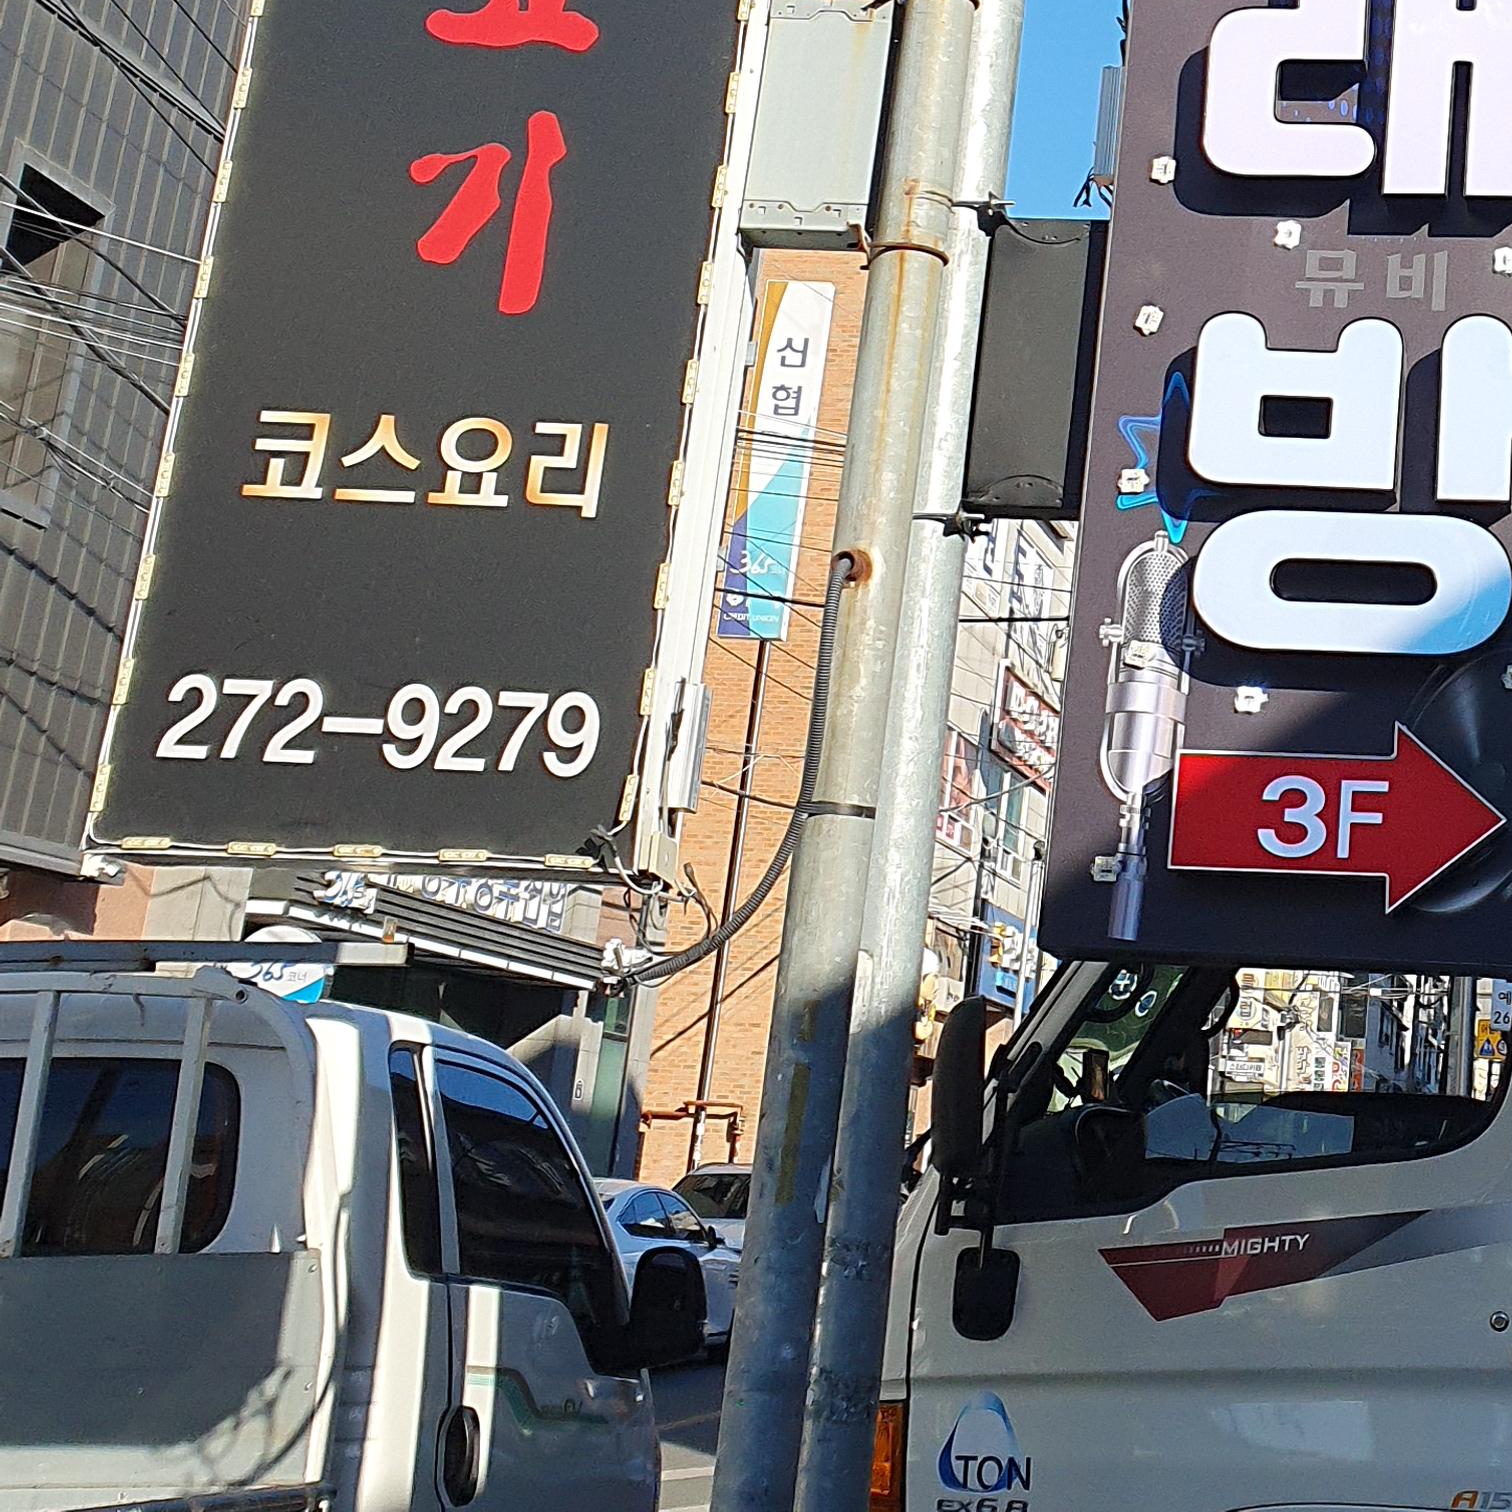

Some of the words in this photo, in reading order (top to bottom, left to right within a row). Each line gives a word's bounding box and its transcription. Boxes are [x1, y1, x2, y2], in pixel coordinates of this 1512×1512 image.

[1295, 249, 1448, 311] 뮤비
[772, 337, 810, 416] 신협
[241, 410, 609, 519] 코스요리
[156, 673, 600, 778] 272-9279
[1257, 775, 1390, 859] 3F
[1221, 1233, 1310, 1258] MIGHTY
[954, 1454, 1032, 1491] TON
